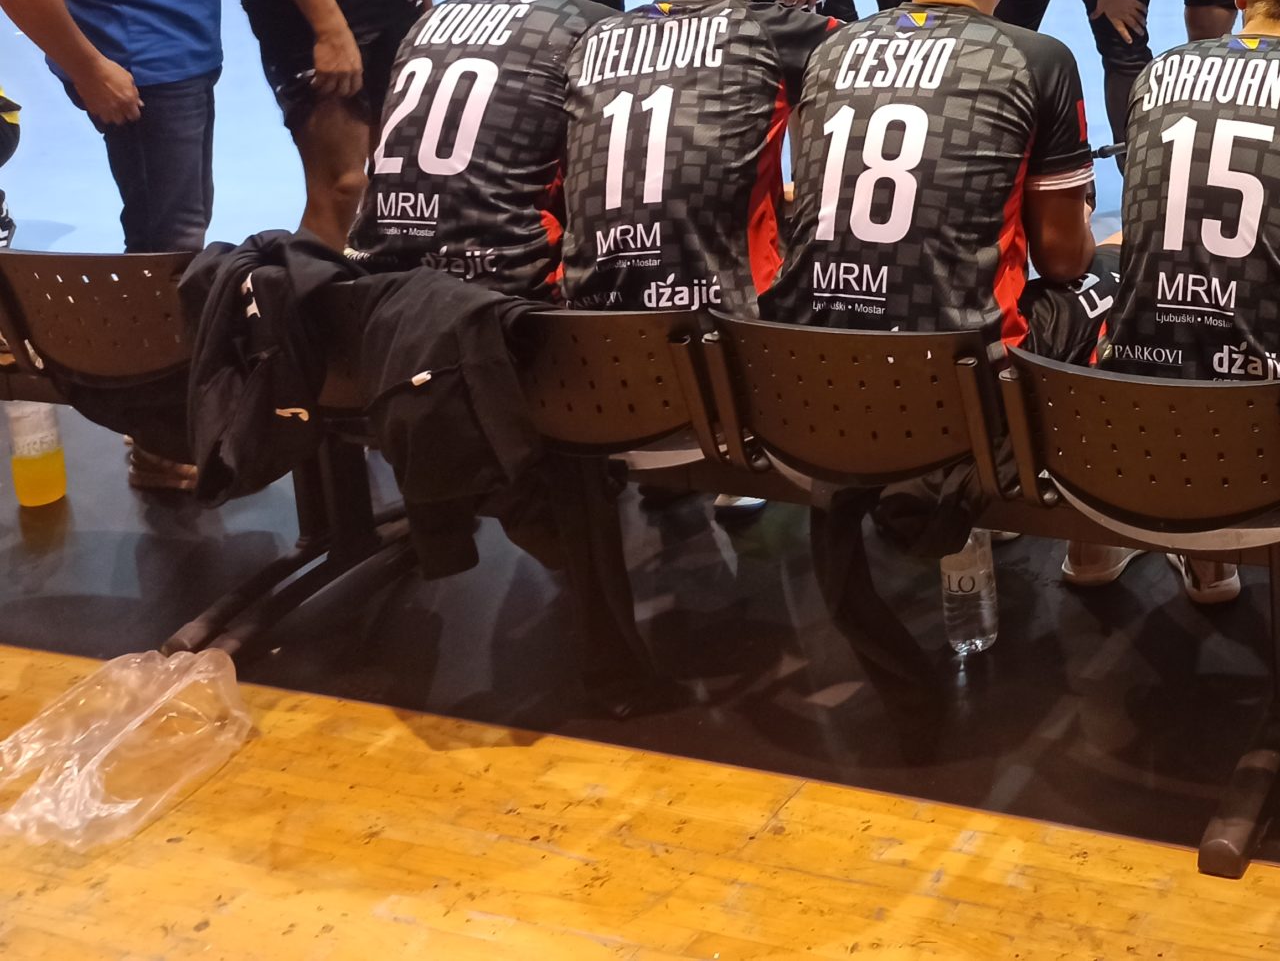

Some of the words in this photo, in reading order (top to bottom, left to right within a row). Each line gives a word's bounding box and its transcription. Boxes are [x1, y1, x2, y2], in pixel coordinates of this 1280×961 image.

[576, 8, 733, 88] DŽELILOVIĆ
[834, 30, 957, 91] ĆEŠKO
[373, 57, 500, 177] 20
[602, 84, 675, 210] 11
[815, 103, 930, 244] 18
[1161, 115, 1275, 259] 15
[376, 192, 440, 219] MRM
[595, 221, 662, 256] MRM
[643, 272, 722, 311] džajić
[812, 261, 889, 294] MRM
[1157, 271, 1238, 309] MRM
[854, 303, 886, 316] Mostar
[1155, 311, 1196, 325] Ljubuški
[1114, 344, 1183, 364] PARKOVI
